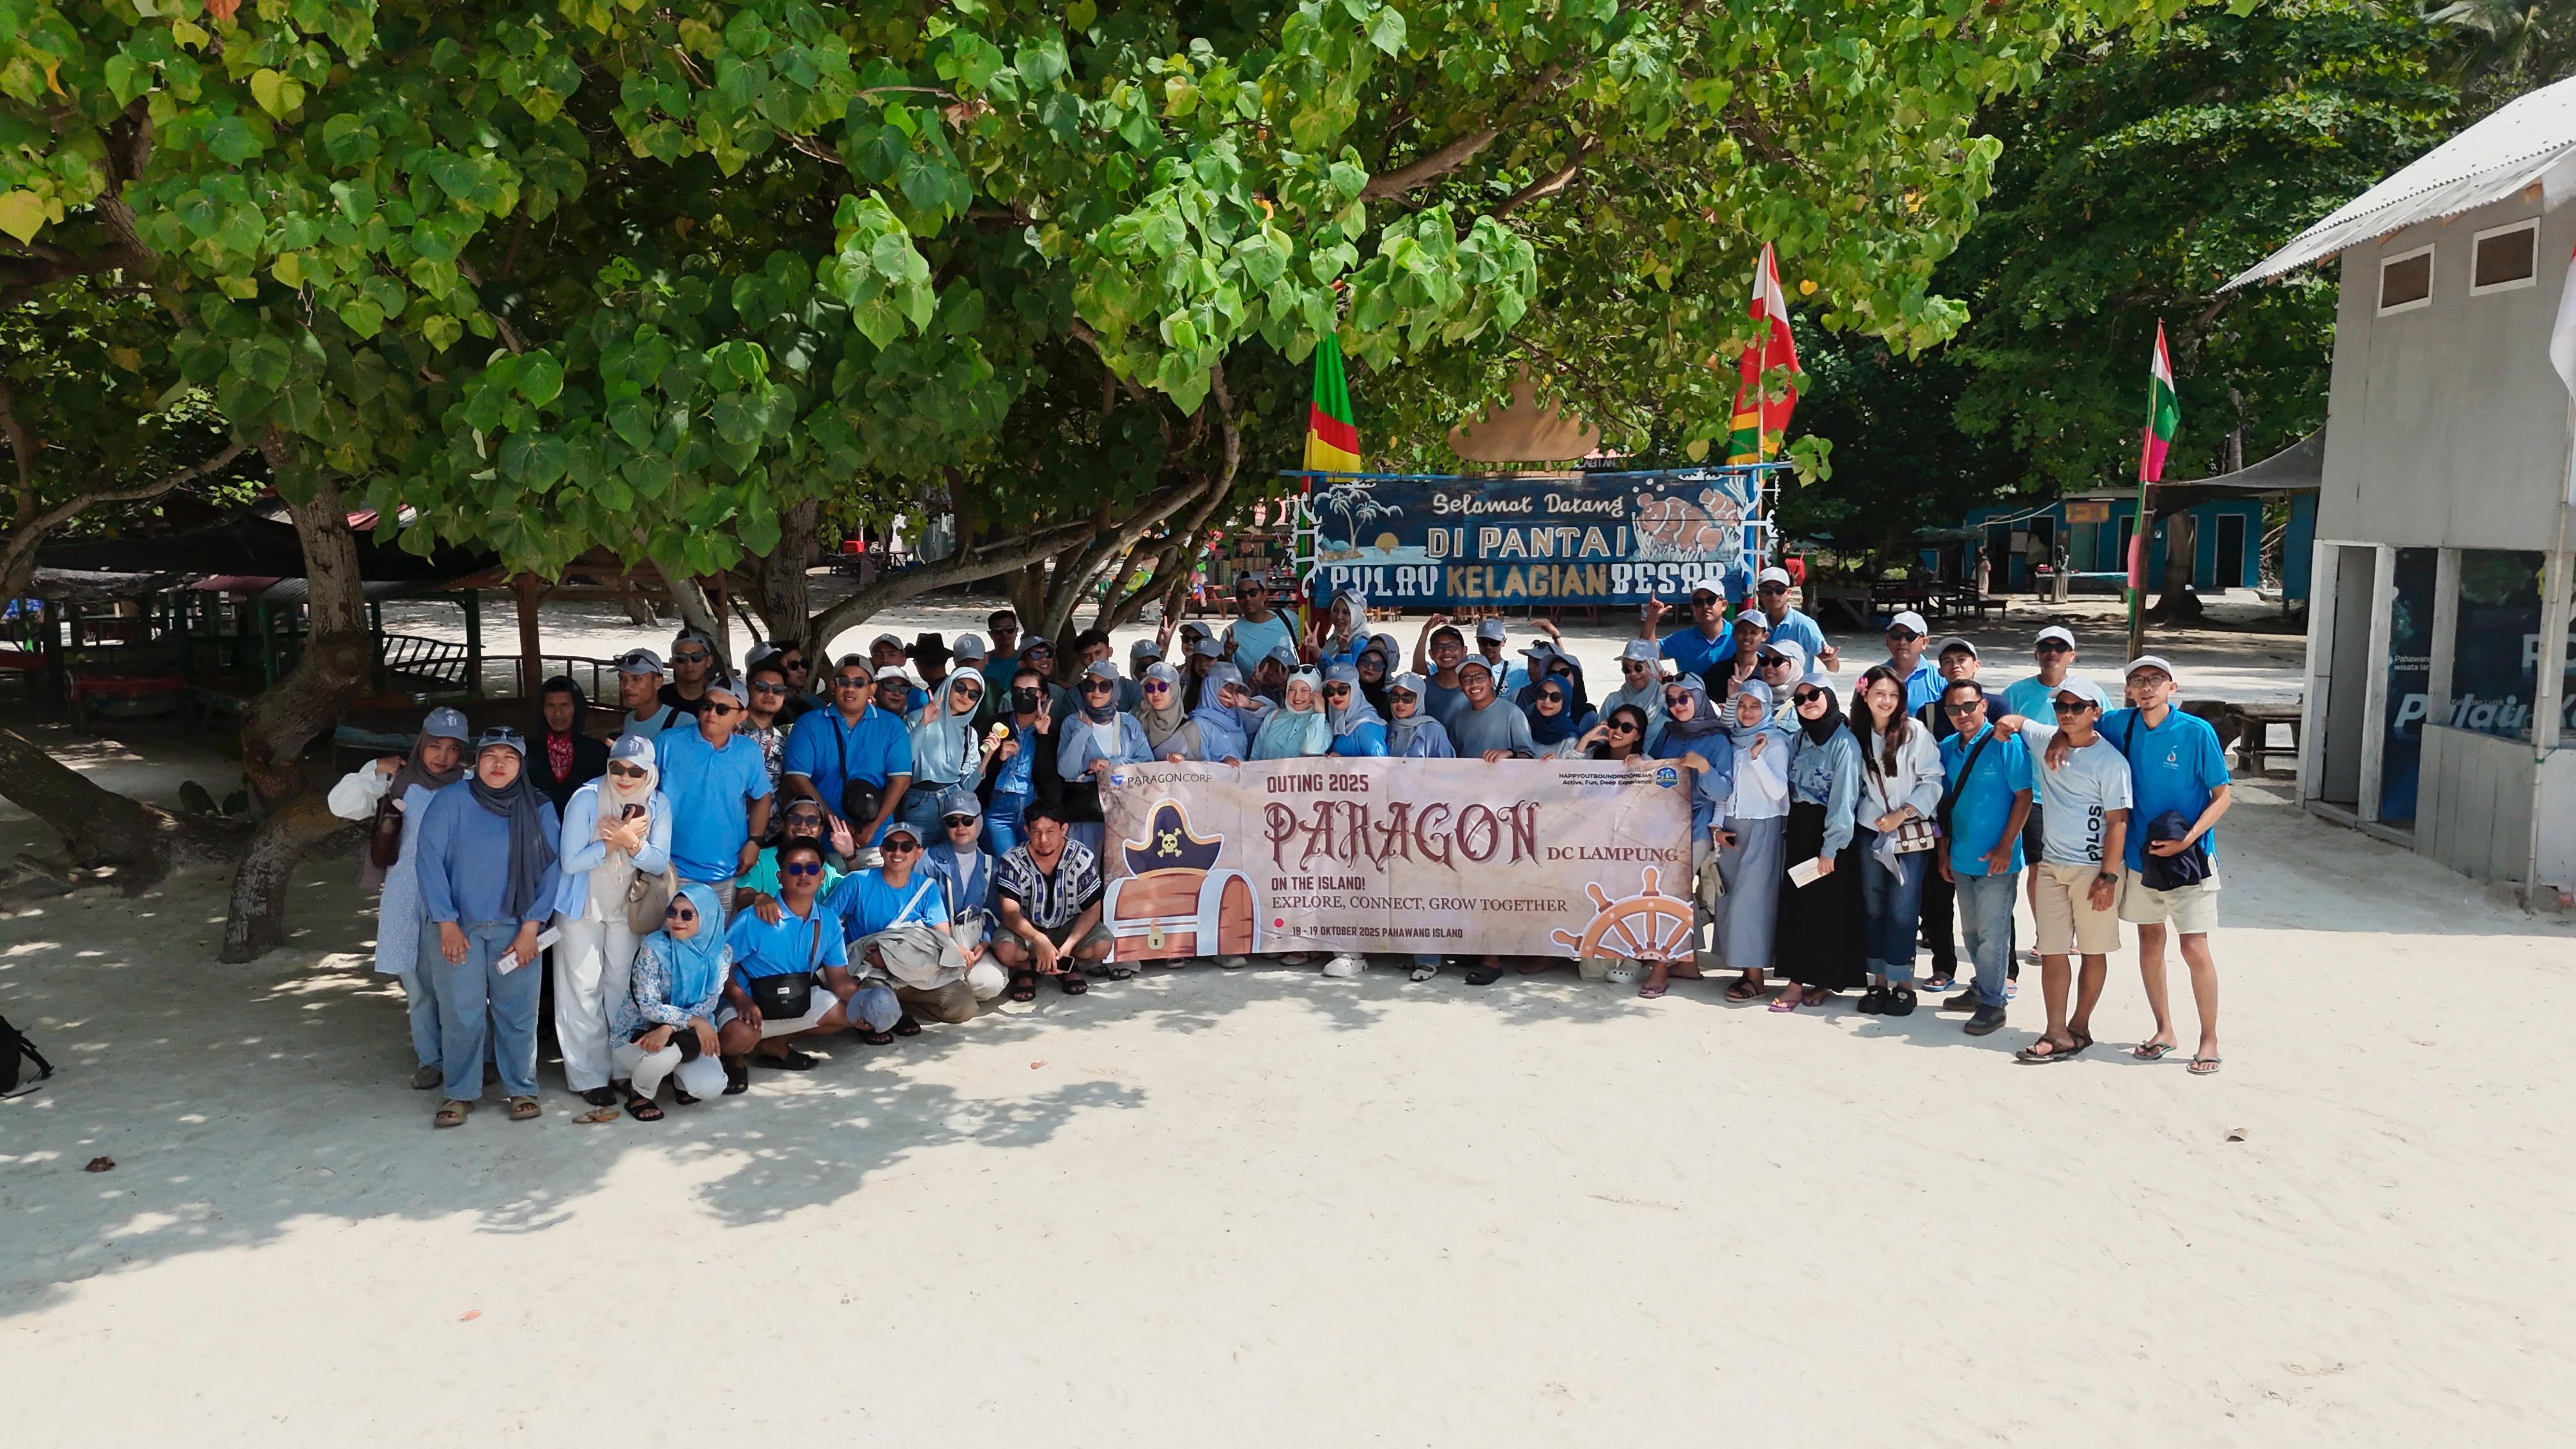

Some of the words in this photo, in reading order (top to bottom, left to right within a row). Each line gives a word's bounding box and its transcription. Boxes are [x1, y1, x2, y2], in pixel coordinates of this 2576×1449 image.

[1433, 493, 1533, 515] Selamat
[1544, 493, 1623, 518] Datang
[1428, 528, 1464, 558] DI
[1479, 526, 1626, 558] PANTAI
[1331, 565, 1438, 596] PULAU
[1446, 564, 1607, 598] KELAGIAN
[1611, 563, 1726, 594] BESAR
[1127, 773, 1213, 788] PARAGONCORP
[1267, 774, 1323, 793] OUTING
[1329, 774, 1369, 792] 2025
[1264, 799, 1541, 873] PARAGON
[1547, 847, 1574, 860] DC
[1578, 847, 1678, 861] LAMPUNG
[1271, 878, 1287, 890] ON
[1291, 877, 1314, 890] THE
[1318, 876, 1365, 890] ISLAND!
[1272, 896, 1346, 909] EXPLORE,
[1349, 897, 1425, 911] CONNECT,
[1429, 898, 1477, 910] GROW
[1480, 898, 1568, 912] TOGETHER
[1292, 927, 1301, 936] 18
[1310, 926, 1317, 935] 19
[1320, 926, 1357, 936] OKTOBER
[1360, 926, 1379, 937] 2025
[1382, 928, 1430, 938] PAHAWANG
[1433, 928, 1463, 938] ISLAND
